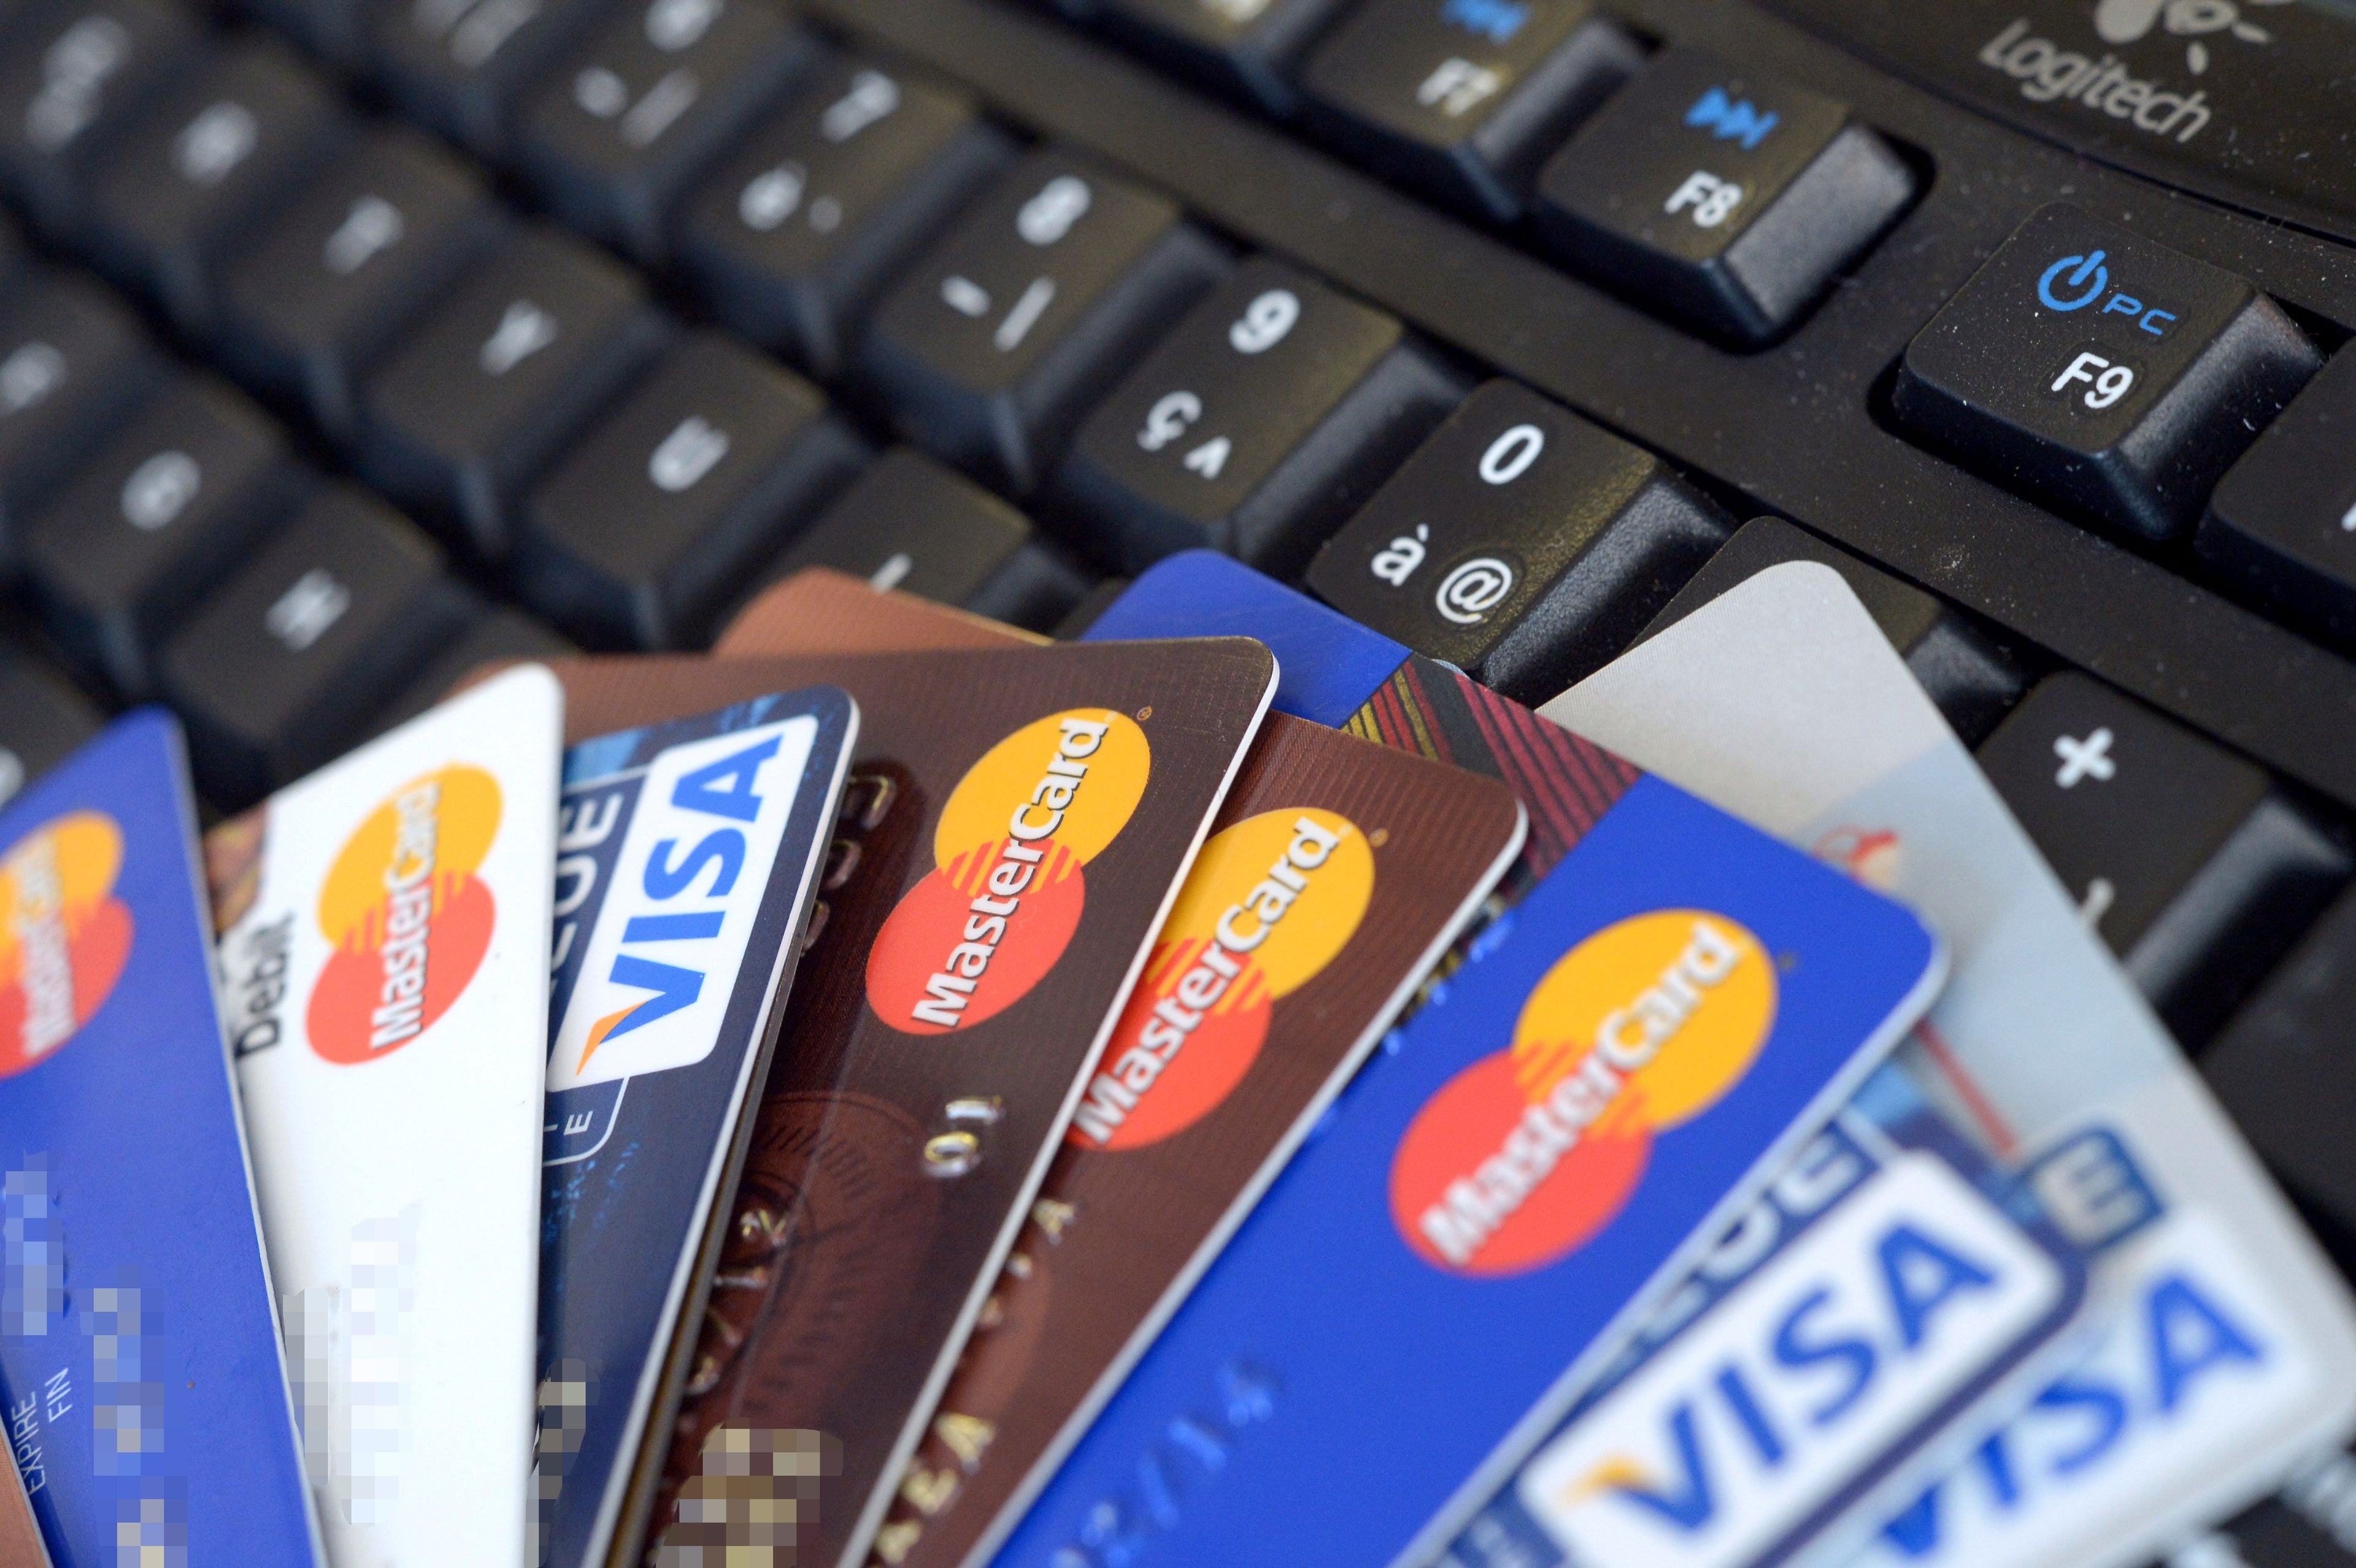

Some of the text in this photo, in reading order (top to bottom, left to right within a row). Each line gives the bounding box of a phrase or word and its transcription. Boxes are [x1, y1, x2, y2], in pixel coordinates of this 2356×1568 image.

[1979, 18, 2211, 143] Logitech
[1663, 170, 1742, 228] F8
[1229, 289, 1301, 354] 9
[2103, 293, 2177, 336] PC
[2051, 352, 2134, 409] F9
[1436, 557, 1513, 624] @
[371, 782, 443, 1051] MasterCard
[576, 732, 787, 1077] VISA
[911, 717, 1111, 1028] MasterCard
[1072, 815, 1341, 1145] MasterCard
[1419, 920, 1744, 1267] MasterCard
[44, 1367, 73, 1423] FIN
[1552, 1218, 1998, 1536] VISA
[11, 1391, 47, 1496] EXPIRE
